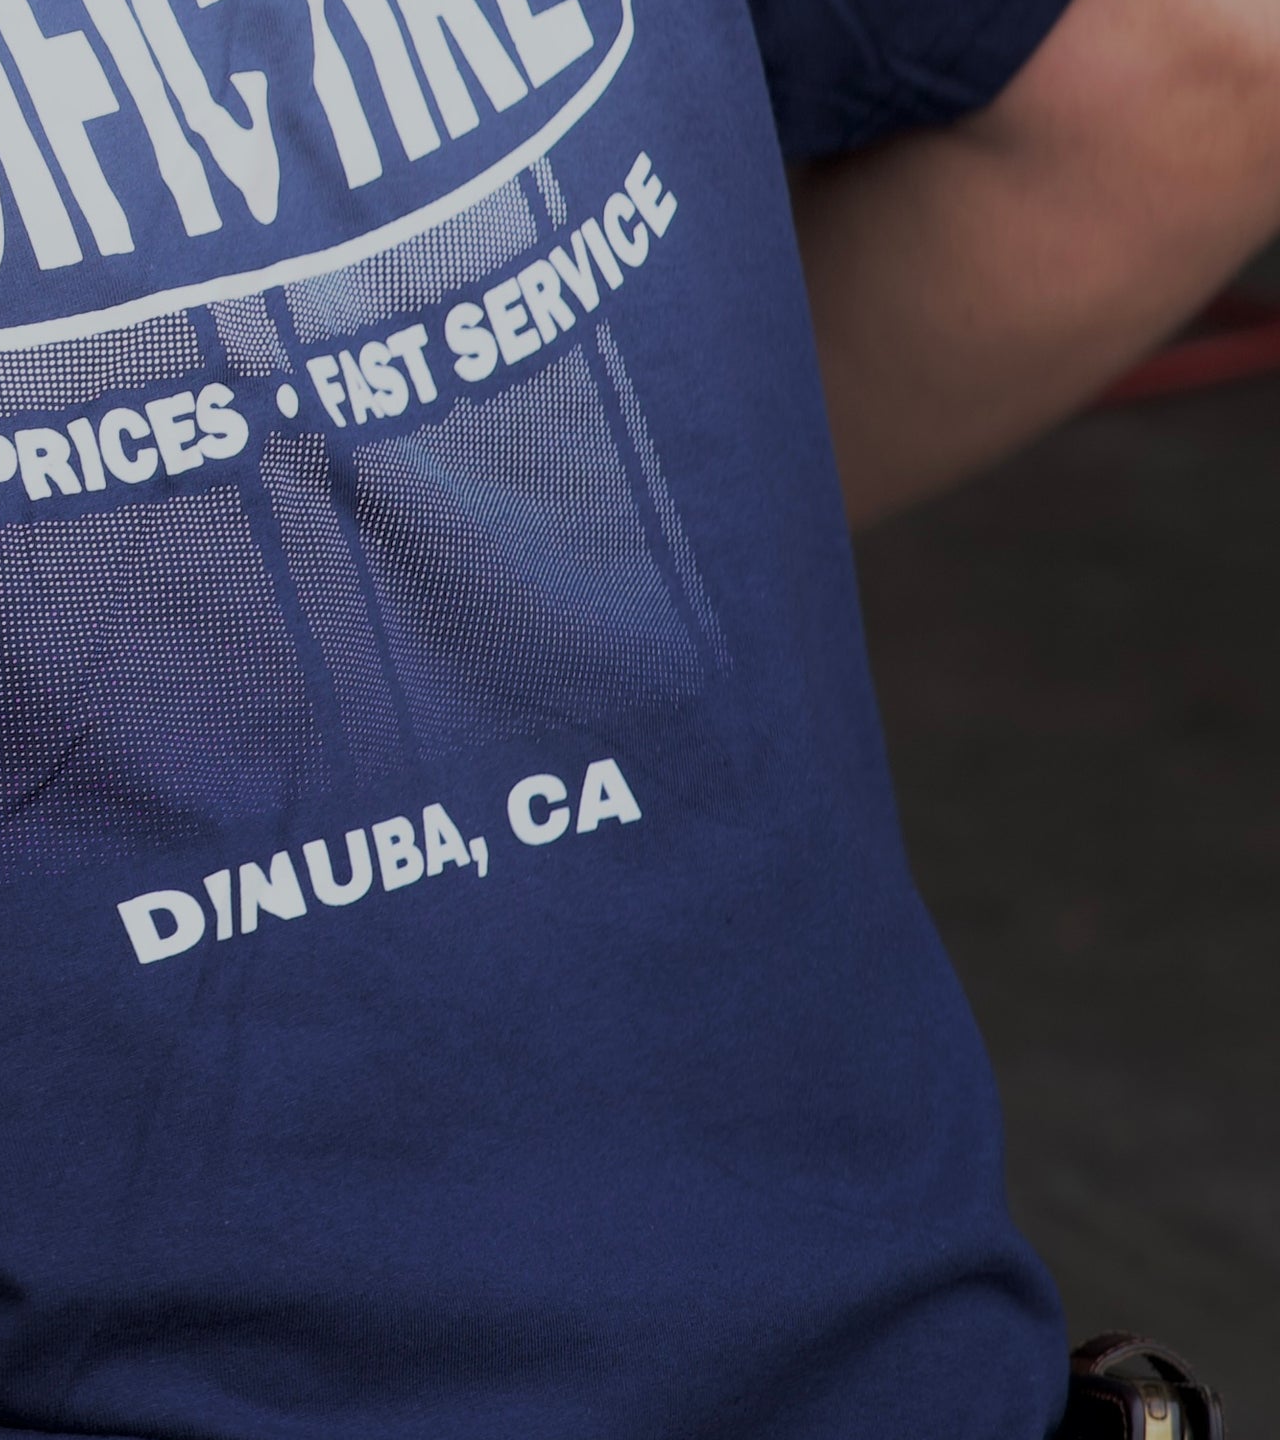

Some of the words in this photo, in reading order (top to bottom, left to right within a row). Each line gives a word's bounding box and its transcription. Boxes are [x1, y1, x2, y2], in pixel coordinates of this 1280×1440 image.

[305, 323, 438, 429] FAST
[444, 151, 678, 383] SERVICE
[116, 802, 489, 965] DINUBA,
[507, 758, 643, 846] CA
